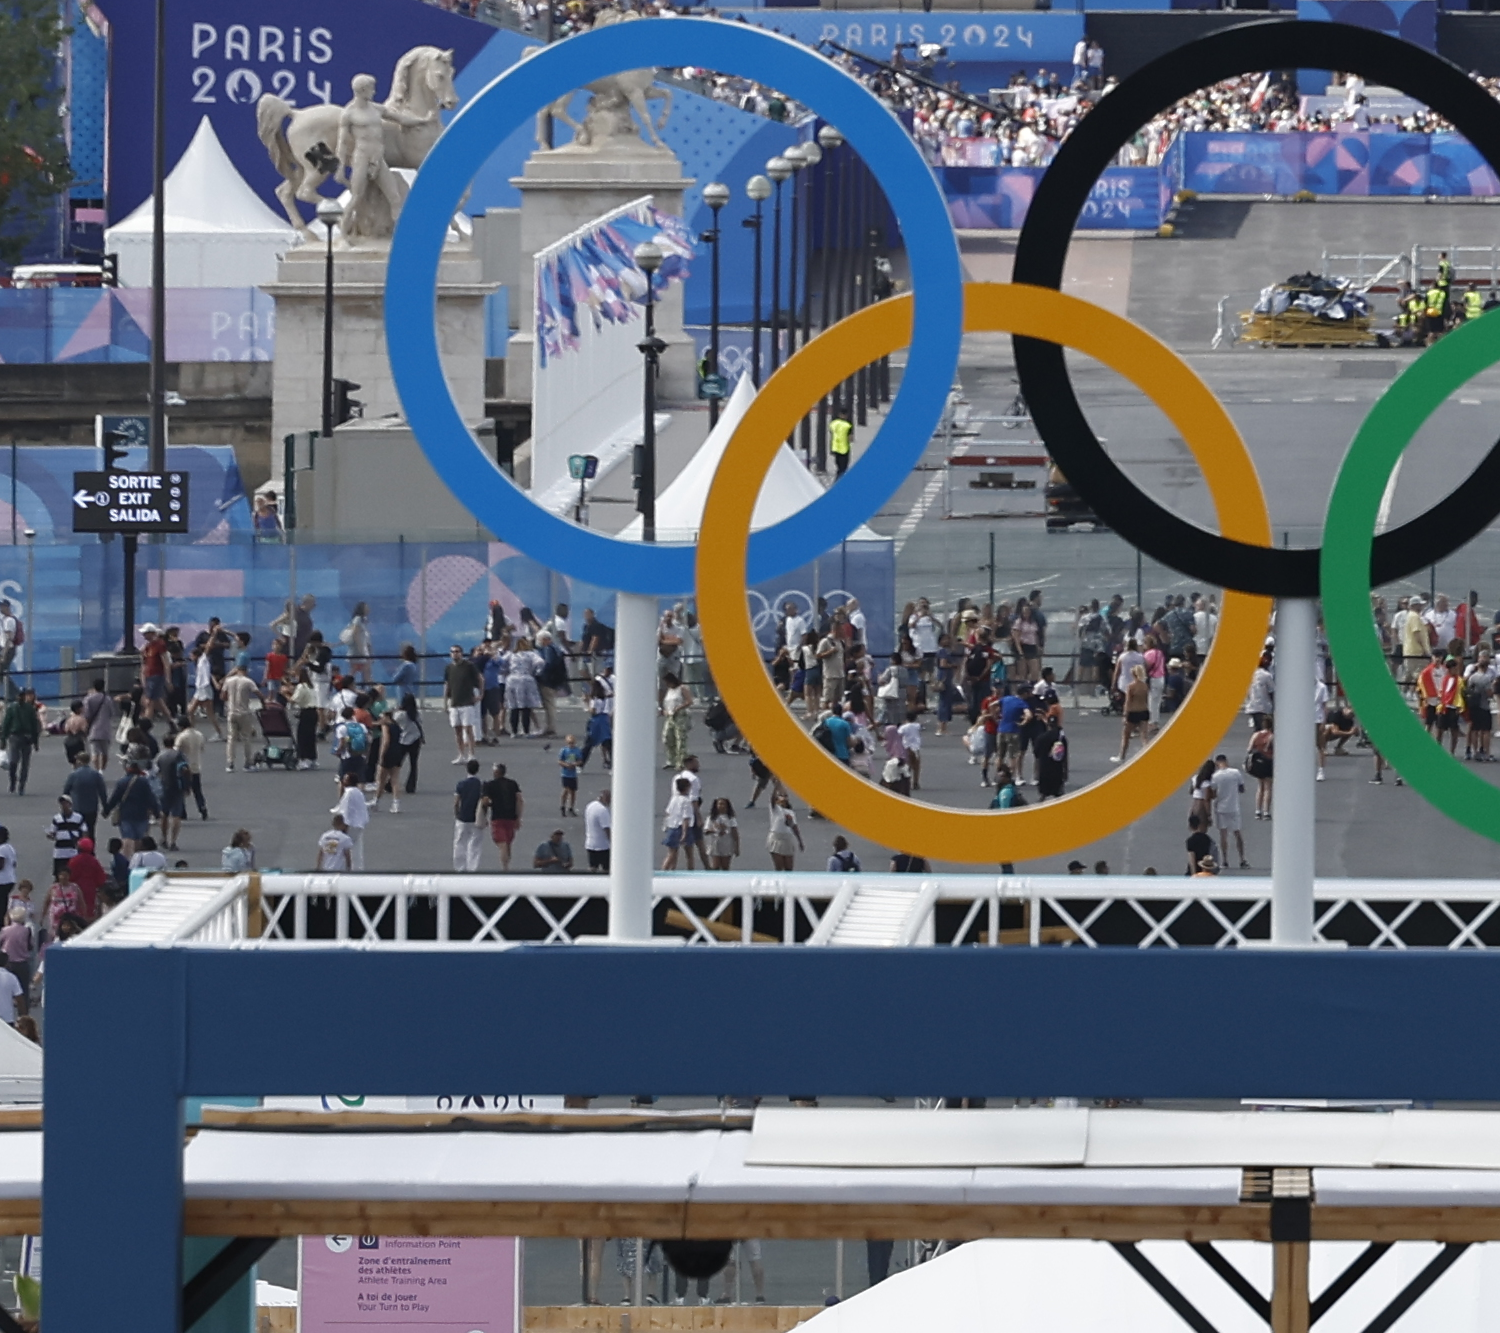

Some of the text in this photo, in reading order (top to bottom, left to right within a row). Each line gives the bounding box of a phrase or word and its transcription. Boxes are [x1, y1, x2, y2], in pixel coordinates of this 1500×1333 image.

[941, 24, 1033, 48] 2024
[192, 65, 332, 106] 2024
[1082, 200, 1131, 218] 024
[108, 475, 163, 489] SORTIE
[118, 492, 152, 505] EXIT
[109, 508, 161, 522] SALIDA
[385, 1240, 461, 1249] Information Point
[359, 1257, 381, 1265] Zone
[358, 1267, 374, 1275] des
[358, 1276, 448, 1286] Athlete Training Area
[366, 1293, 379, 1301] toi
[381, 1293, 393, 1301] de
[394, 1293, 418, 1302] jouer
[357, 1304, 376, 1312] Your
[379, 1304, 398, 1312] Turn
[412, 1303, 430, 1313] Play
